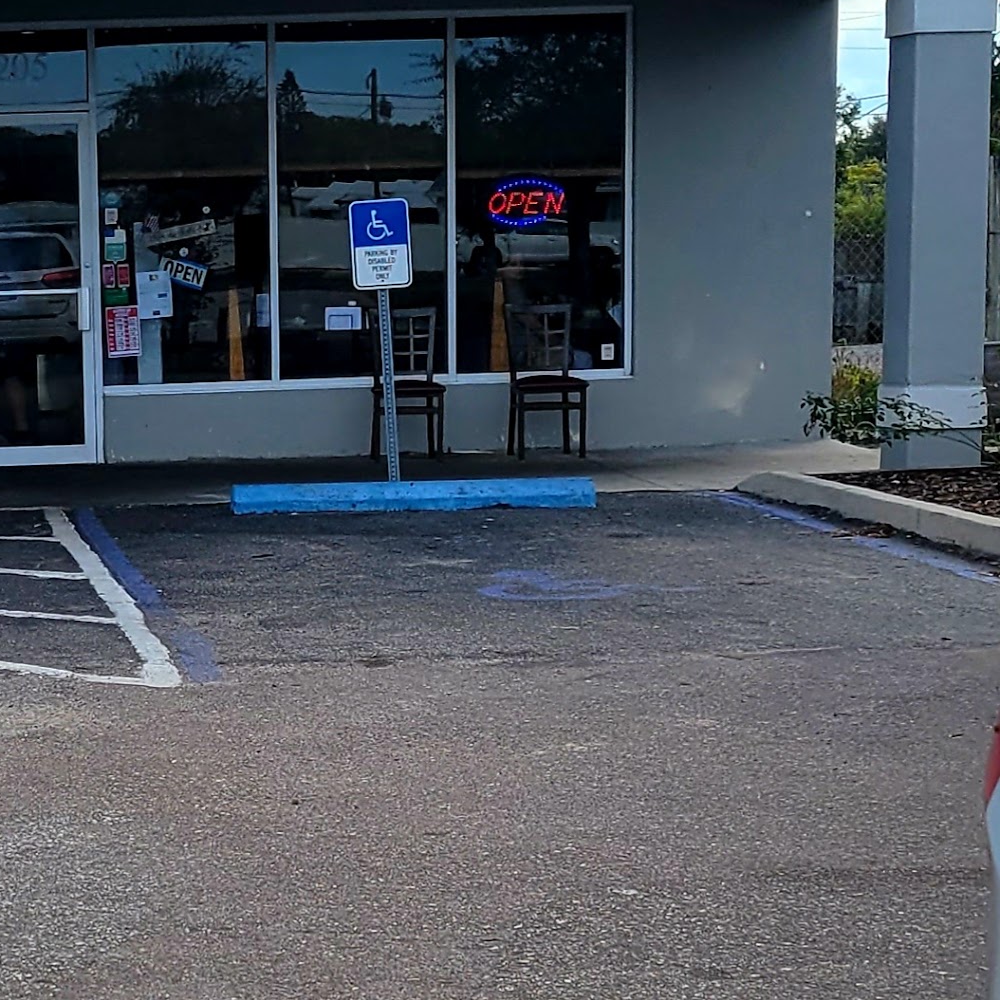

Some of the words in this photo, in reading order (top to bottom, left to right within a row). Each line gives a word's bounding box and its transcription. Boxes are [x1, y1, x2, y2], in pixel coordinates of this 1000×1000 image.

[488, 191, 565, 215] OPEN
[364, 250, 388, 258] PARKING
[368, 257, 396, 265] DISABLED
[372, 264, 392, 272] PERMIT
[163, 260, 204, 285] OPEN
